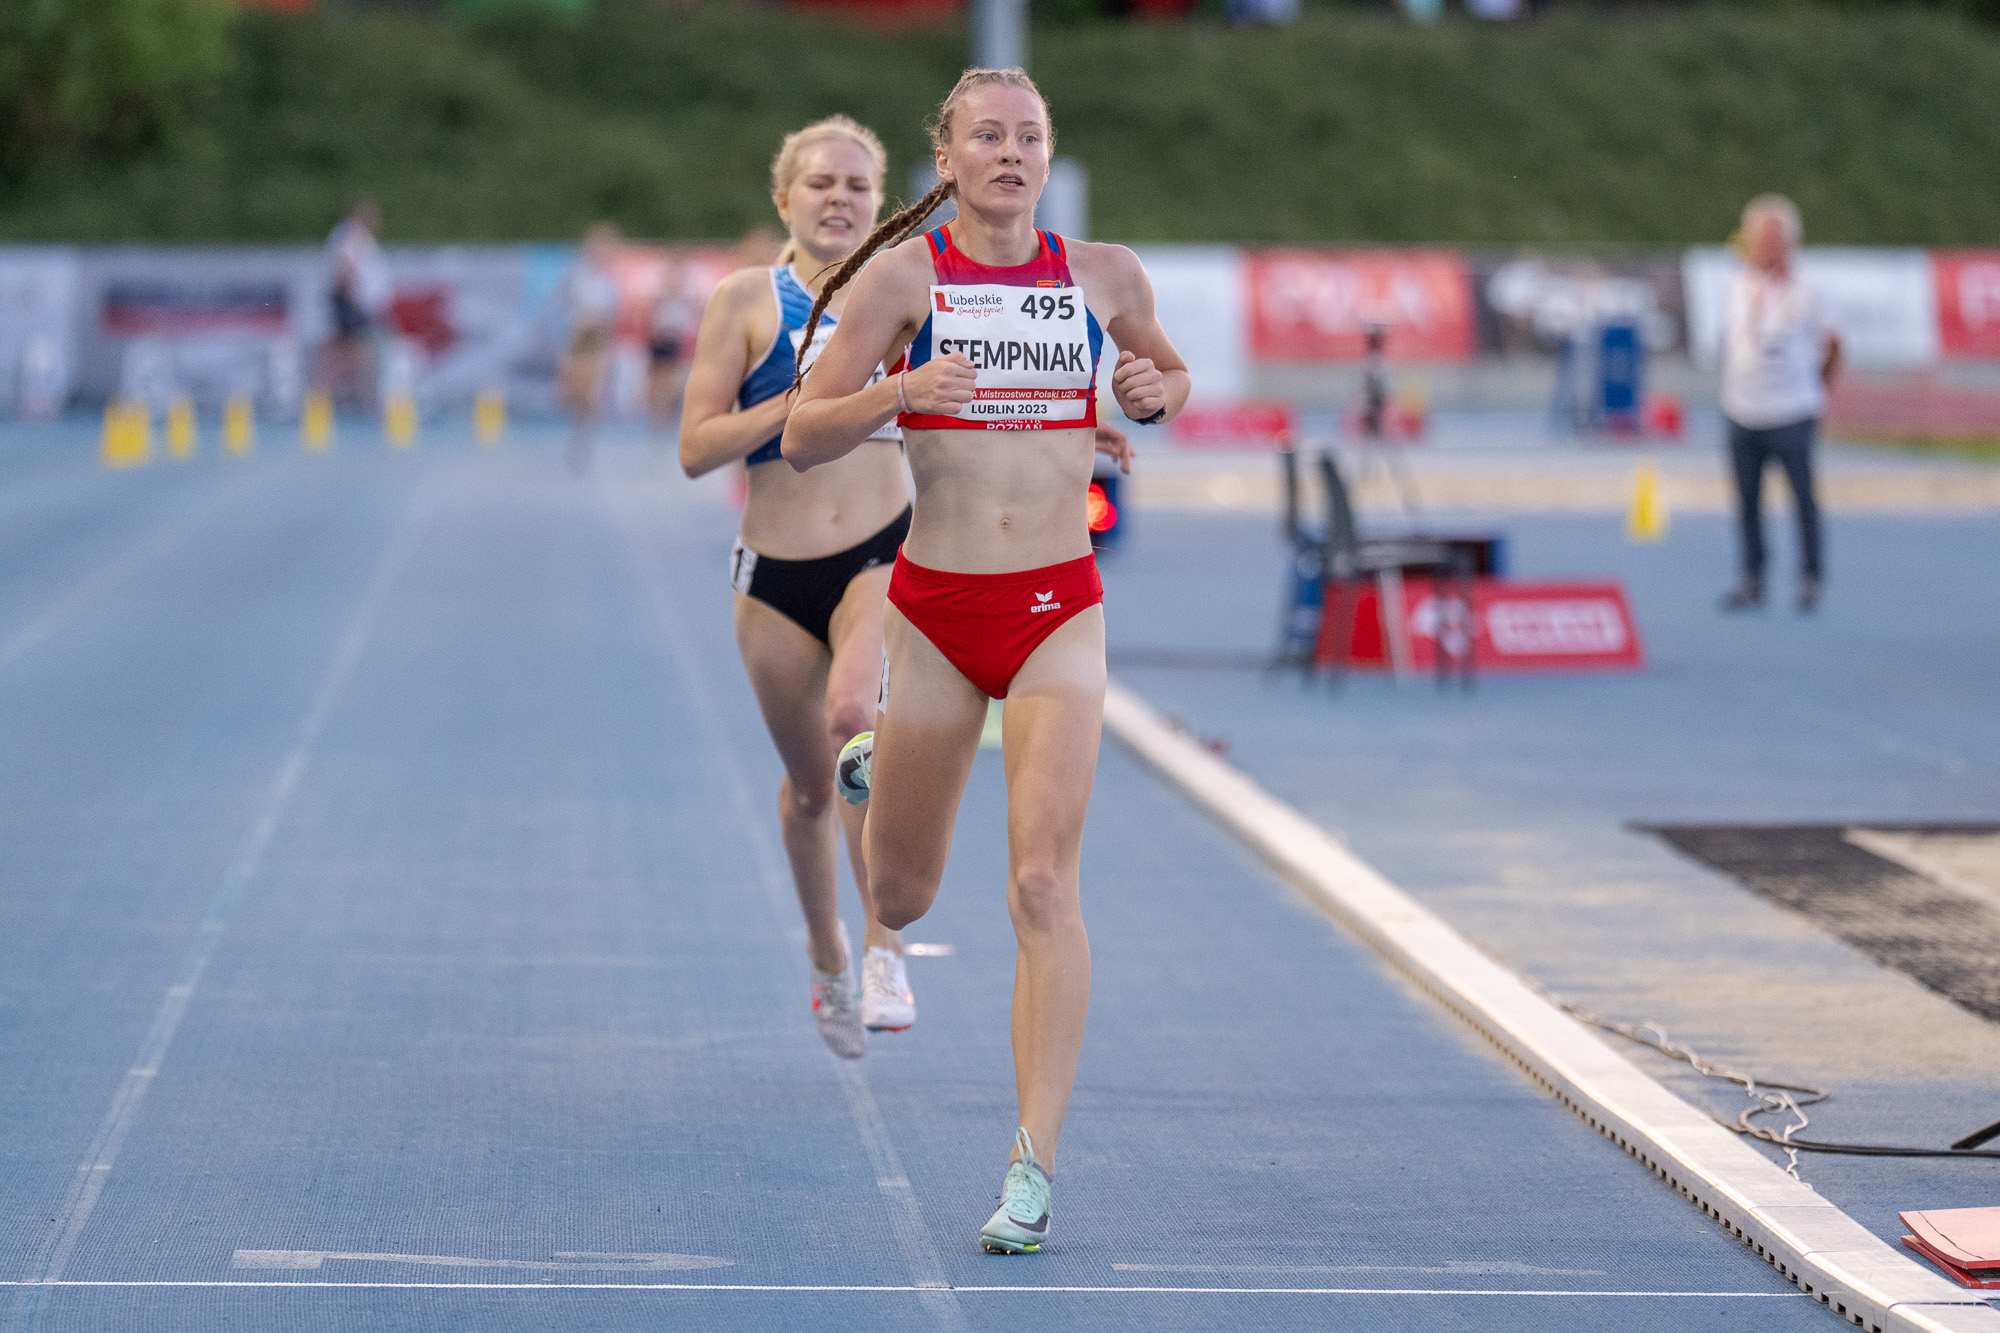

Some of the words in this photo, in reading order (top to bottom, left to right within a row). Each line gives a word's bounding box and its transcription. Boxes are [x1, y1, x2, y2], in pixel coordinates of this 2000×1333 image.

[949, 294, 1003, 305] lubelskie
[1020, 295, 1075, 320] 495
[939, 338, 1085, 372] STEMPNIAK
[979, 390, 1032, 399] Mistrzostwa
[1033, 390, 1060, 399] Polski
[1061, 390, 1077, 399] U20
[971, 404, 1015, 414] LUBLIN
[1017, 404, 1048, 414] 2023
[1030, 602, 1061, 613] erima
